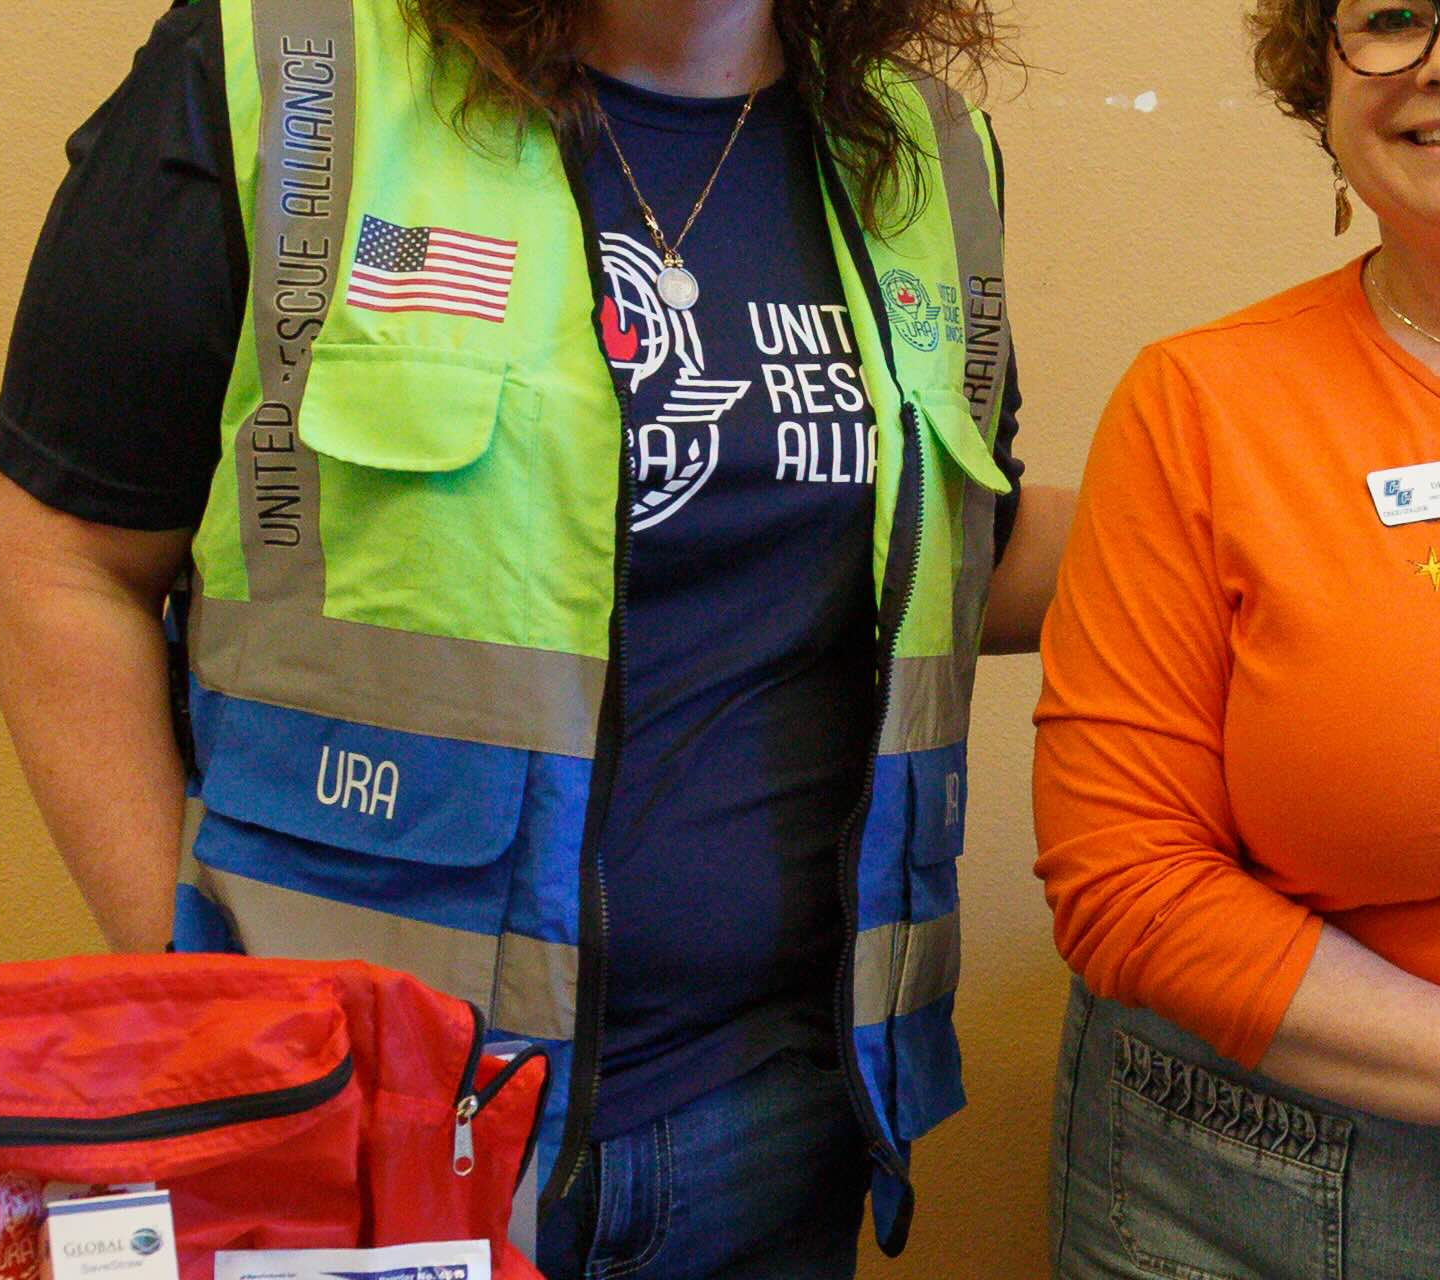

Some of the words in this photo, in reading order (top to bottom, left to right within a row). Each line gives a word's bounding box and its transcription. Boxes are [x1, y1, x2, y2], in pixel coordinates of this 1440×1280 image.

[252, 398, 302, 549] UNITED
[282, 35, 335, 219] ALLIANCE
[963, 275, 1002, 421] RAINER
[315, 745, 401, 820] URA
[63, 1239, 126, 1257] GLOBAL
